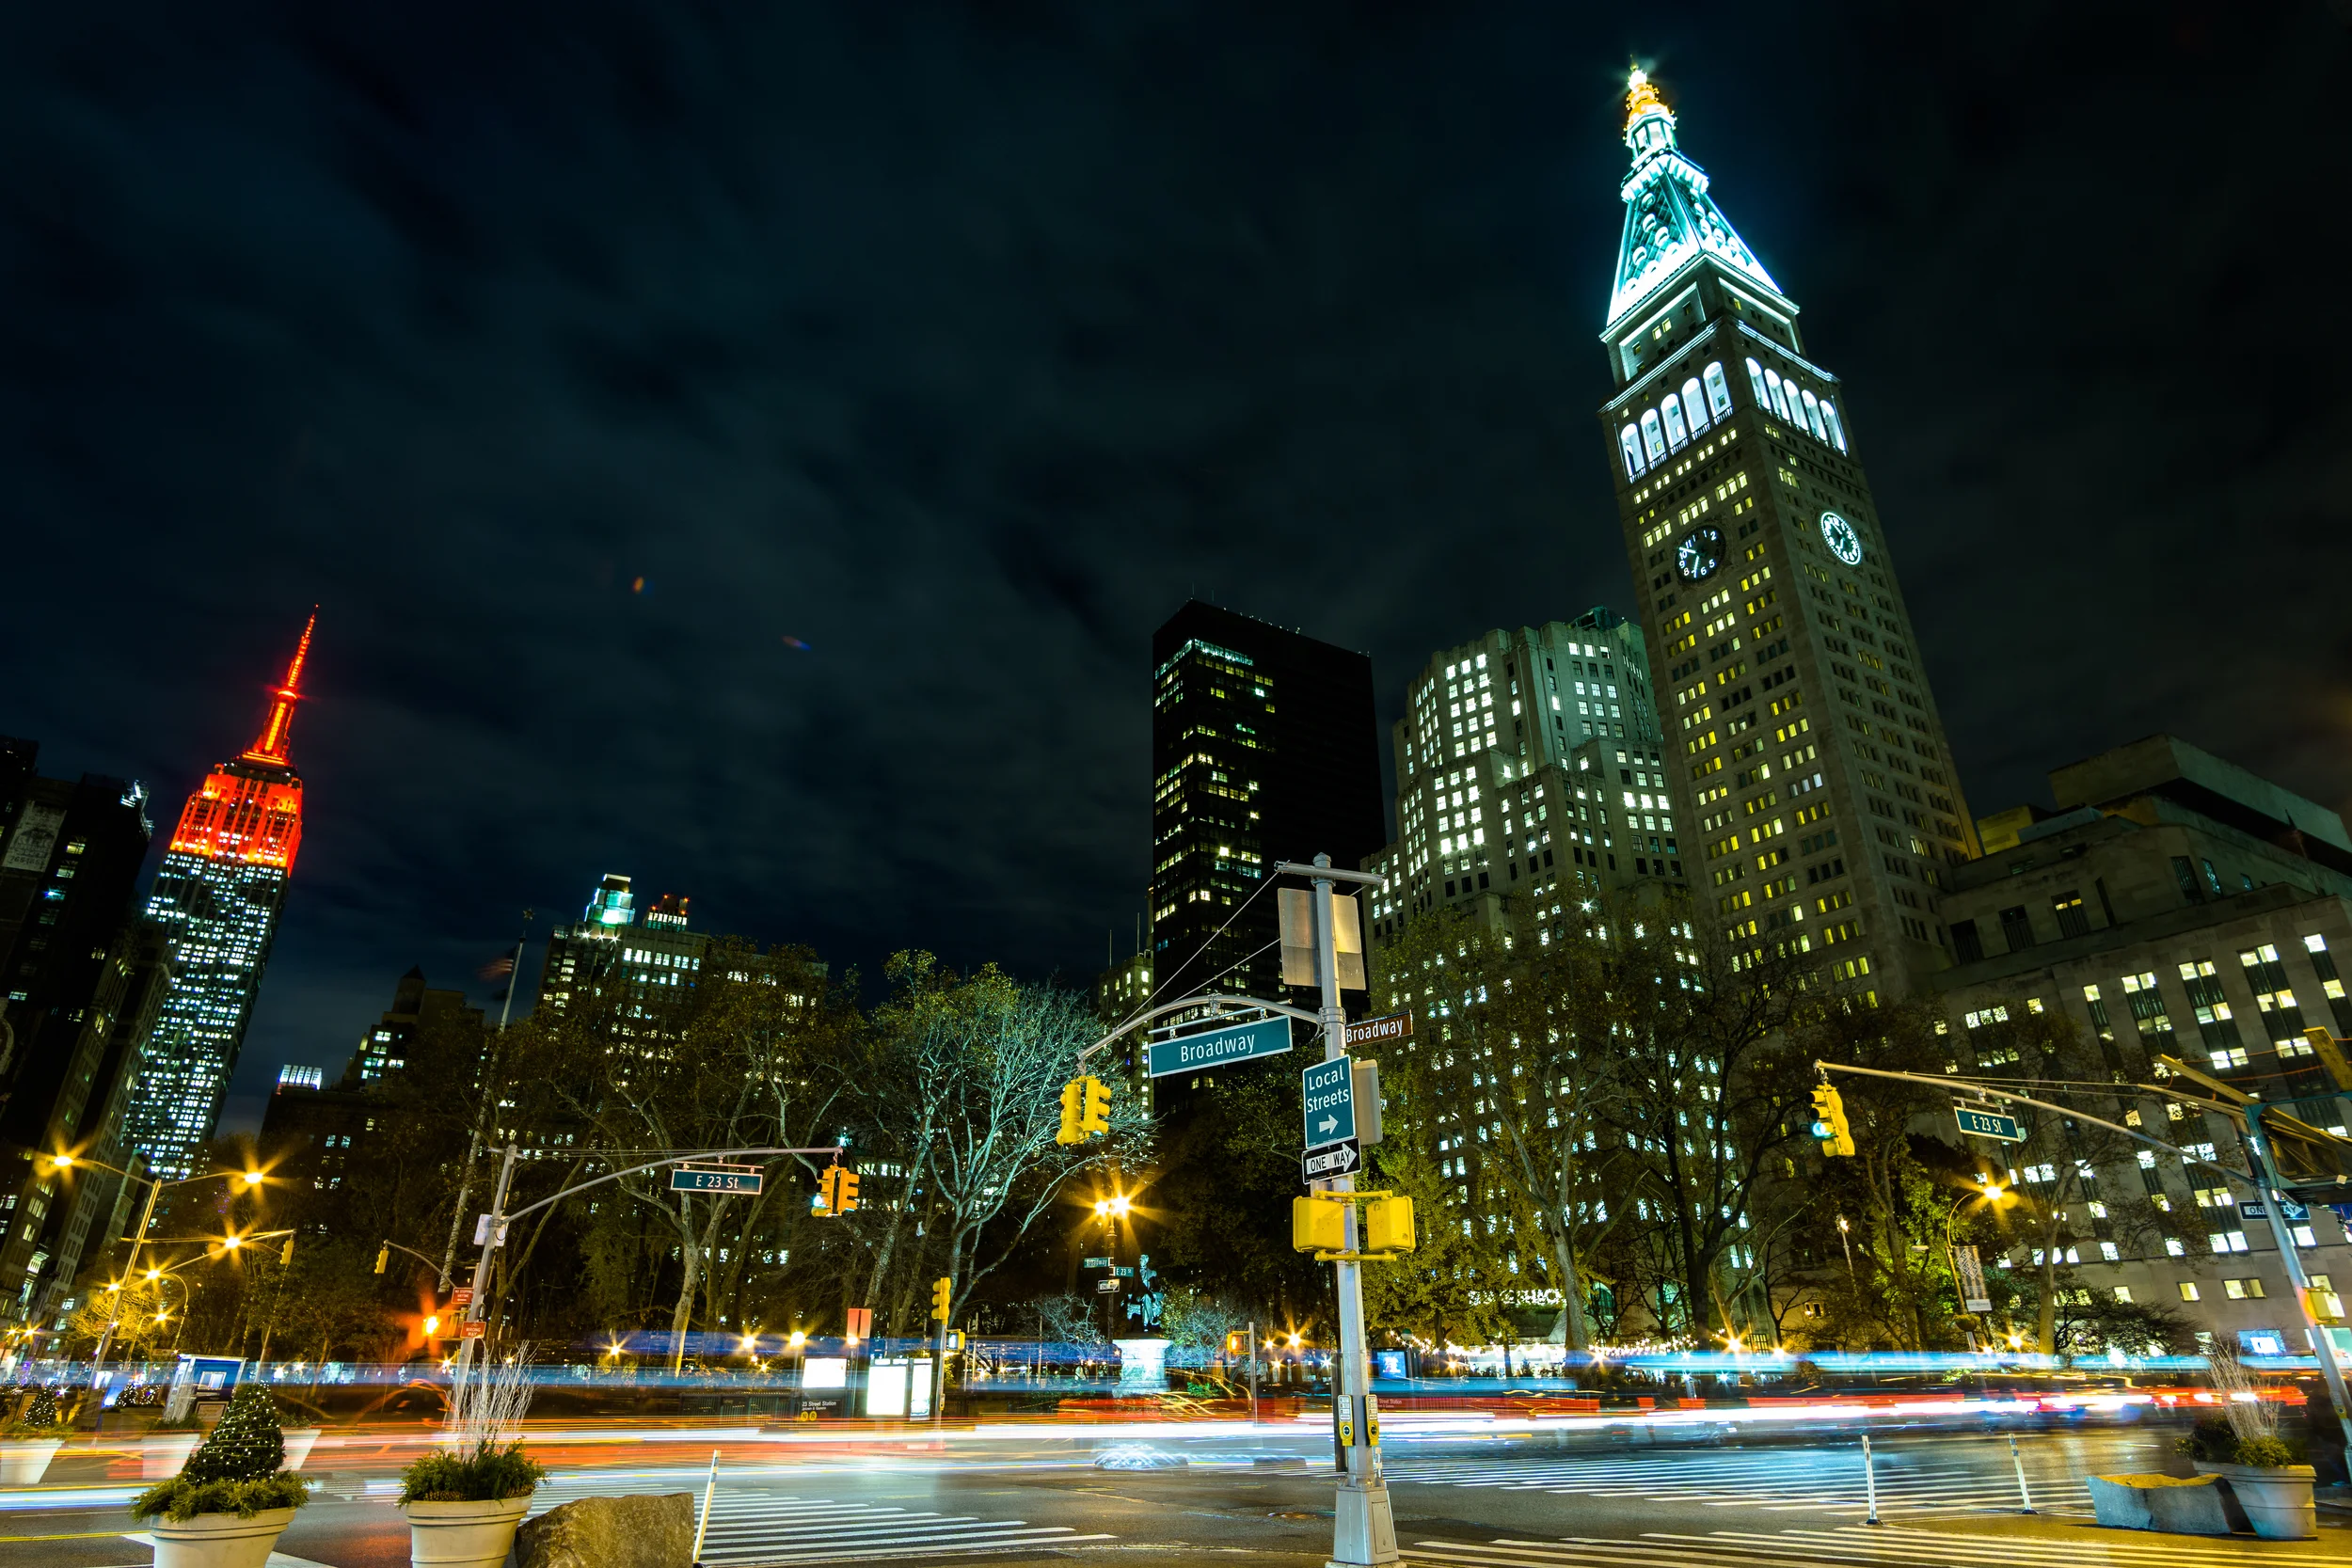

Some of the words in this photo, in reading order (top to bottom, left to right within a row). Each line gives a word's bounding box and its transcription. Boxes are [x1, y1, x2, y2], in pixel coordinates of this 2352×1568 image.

[1346, 1019, 1403, 1043] Broadway
[1181, 1034, 1255, 1063] Broadway
[1309, 1064, 1343, 1091] Local
[1307, 1088, 1349, 1113] Streets
[1971, 1115, 1979, 1130] E
[1979, 1117, 1991, 1132] 23
[1993, 1118, 2003, 1133] St
[1311, 1156, 1327, 1172] ONE
[1333, 1149, 1351, 1166] WAY
[696, 1175, 703, 1187] E
[707, 1176, 722, 1188] 23
[726, 1177, 739, 1189] St
